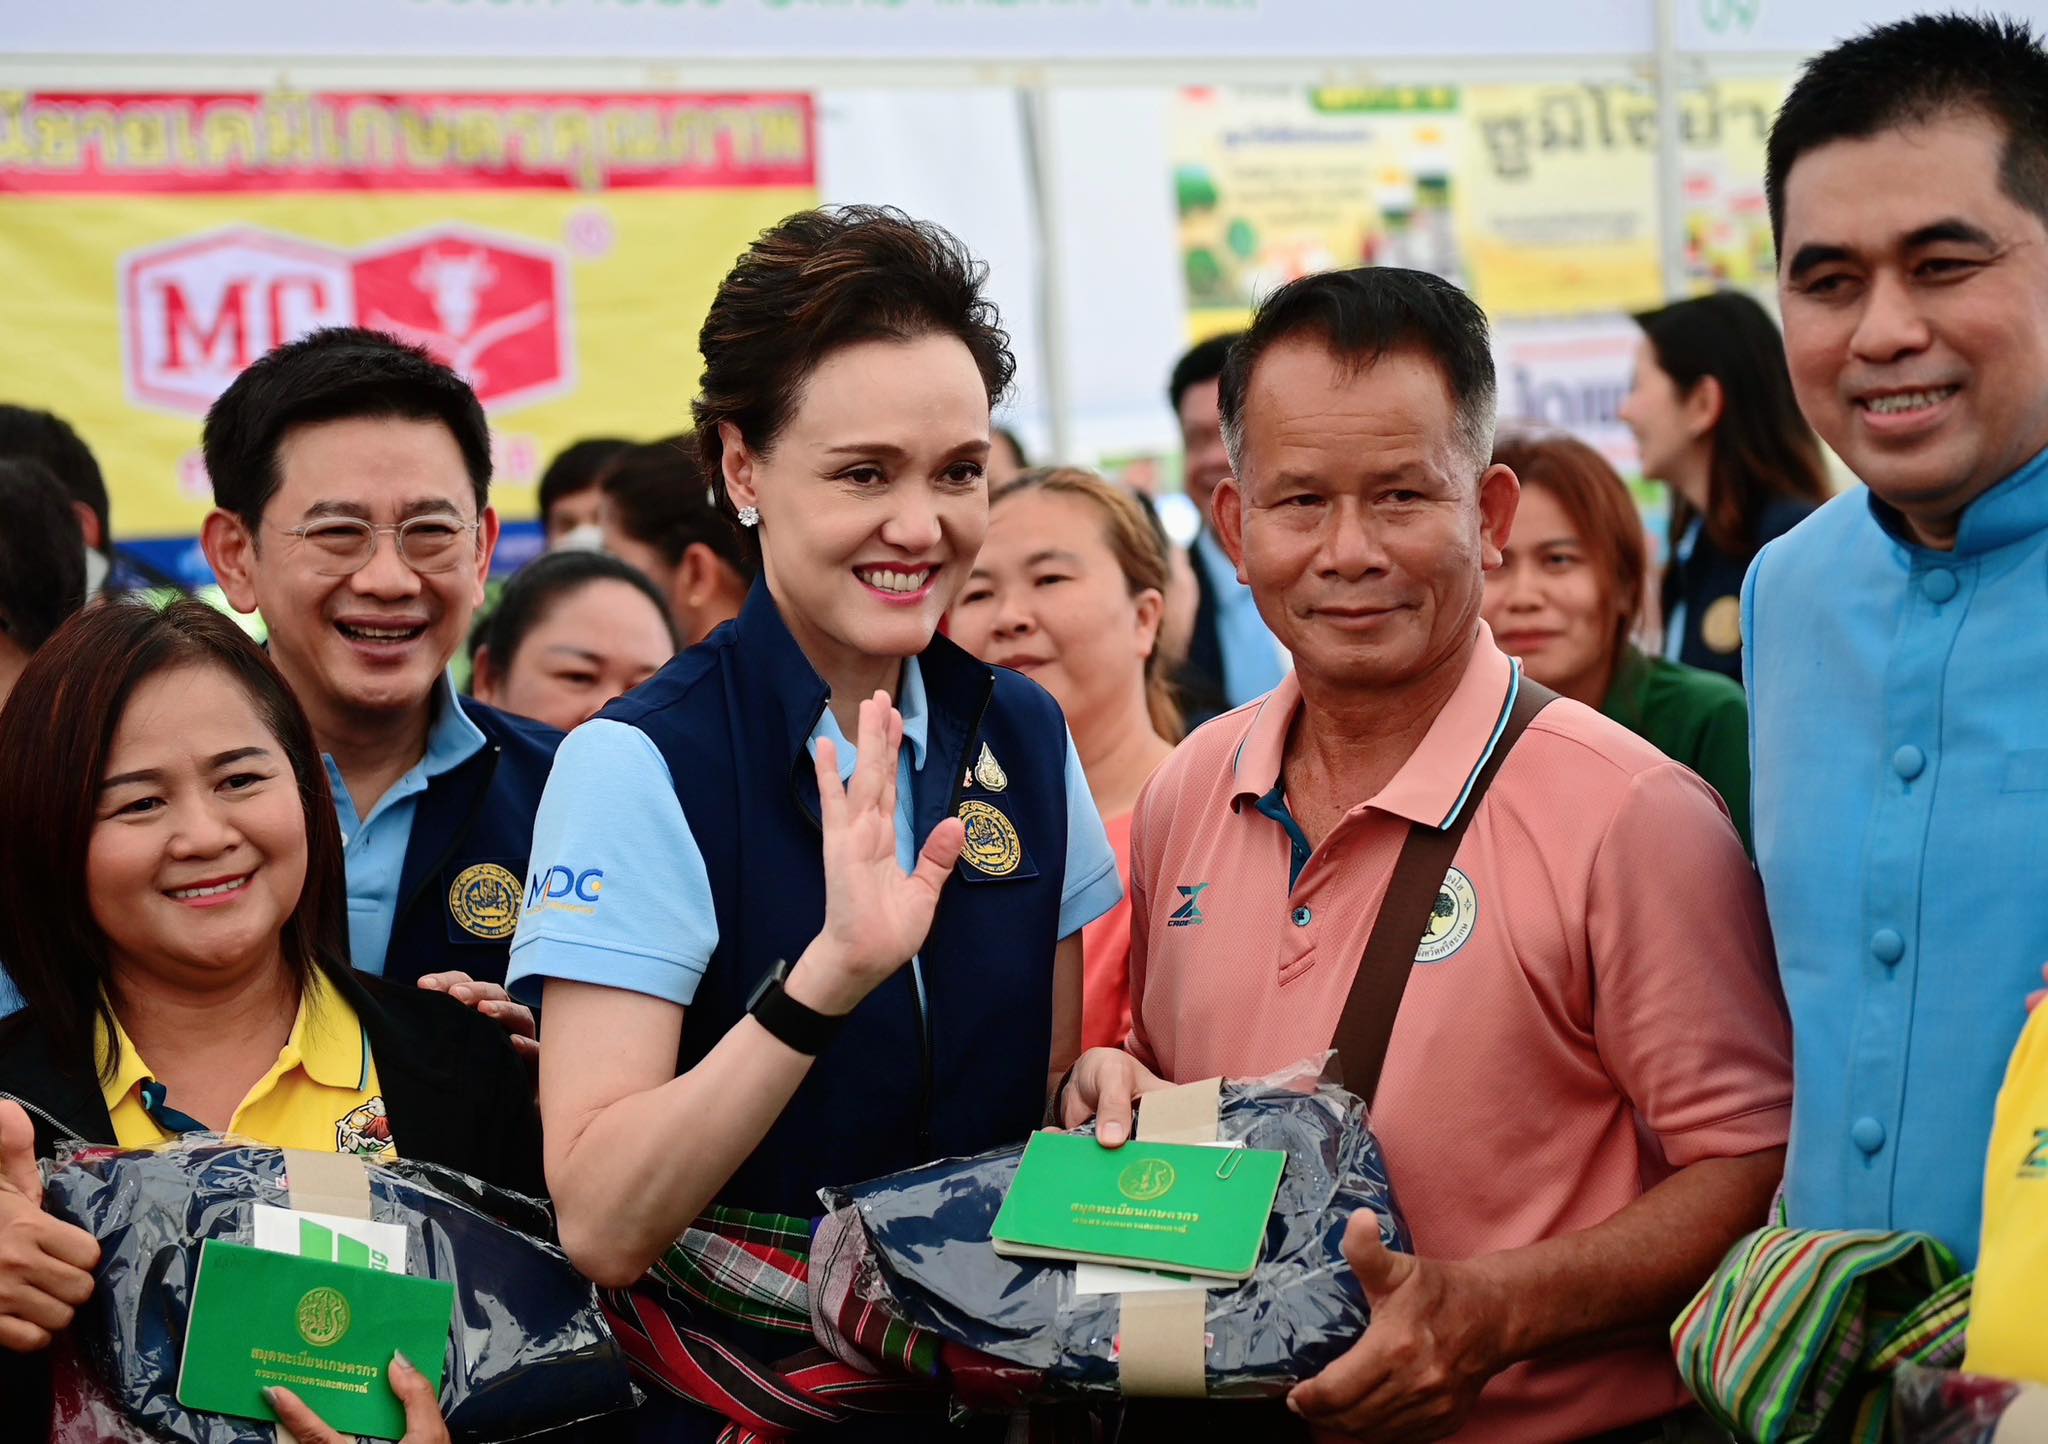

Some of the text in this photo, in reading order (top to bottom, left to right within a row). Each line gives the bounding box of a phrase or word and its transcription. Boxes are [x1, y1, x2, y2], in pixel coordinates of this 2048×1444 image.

[1070, 1202, 1200, 1223] สมุดทะเบียนเกษตรกร
[250, 1347, 378, 1378] สมุดทะเบียนเกษตรกร
[254, 1368, 370, 1394] กระทรวงเกษตรและสหกรณ์
